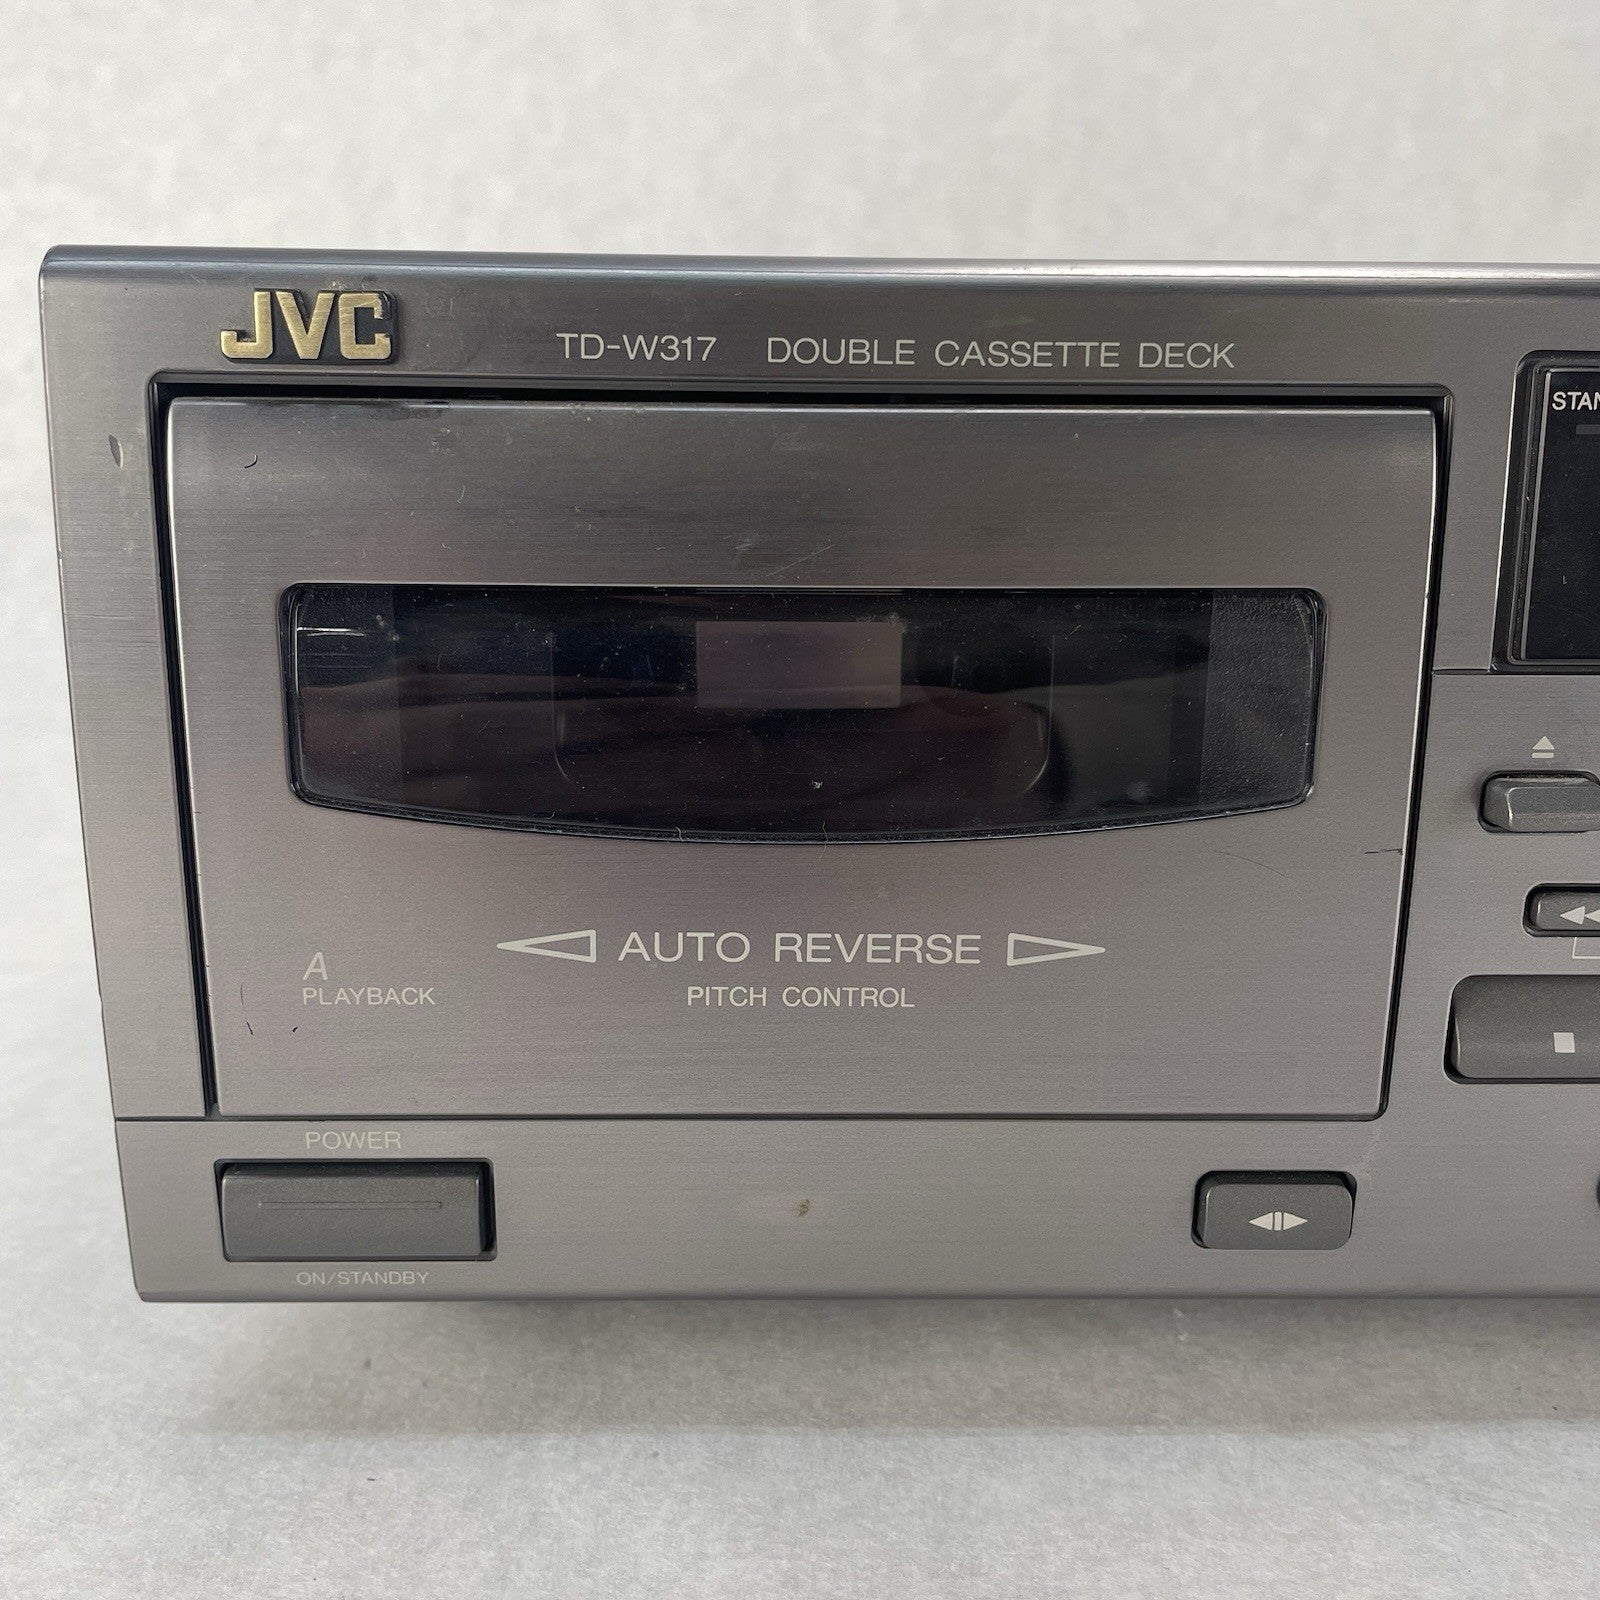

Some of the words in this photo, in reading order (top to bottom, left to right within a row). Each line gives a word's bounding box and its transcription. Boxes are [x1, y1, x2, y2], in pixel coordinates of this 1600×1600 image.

[220, 290, 393, 360] JVC
[556, 333, 717, 361] TD-W317
[767, 337, 916, 365] DOUBLE
[934, 340, 1121, 369] CASSETTE
[1137, 342, 1236, 370] DECK
[618, 931, 752, 964] AUTO
[773, 932, 982, 965] REVERSE
[302, 951, 329, 982] A
[302, 986, 436, 1006] PLAYBACK
[686, 985, 768, 1007] PITCH
[781, 986, 916, 1009] CONTROL
[305, 1130, 402, 1150] POWER
[296, 1270, 430, 1286] ON/STANDBY
